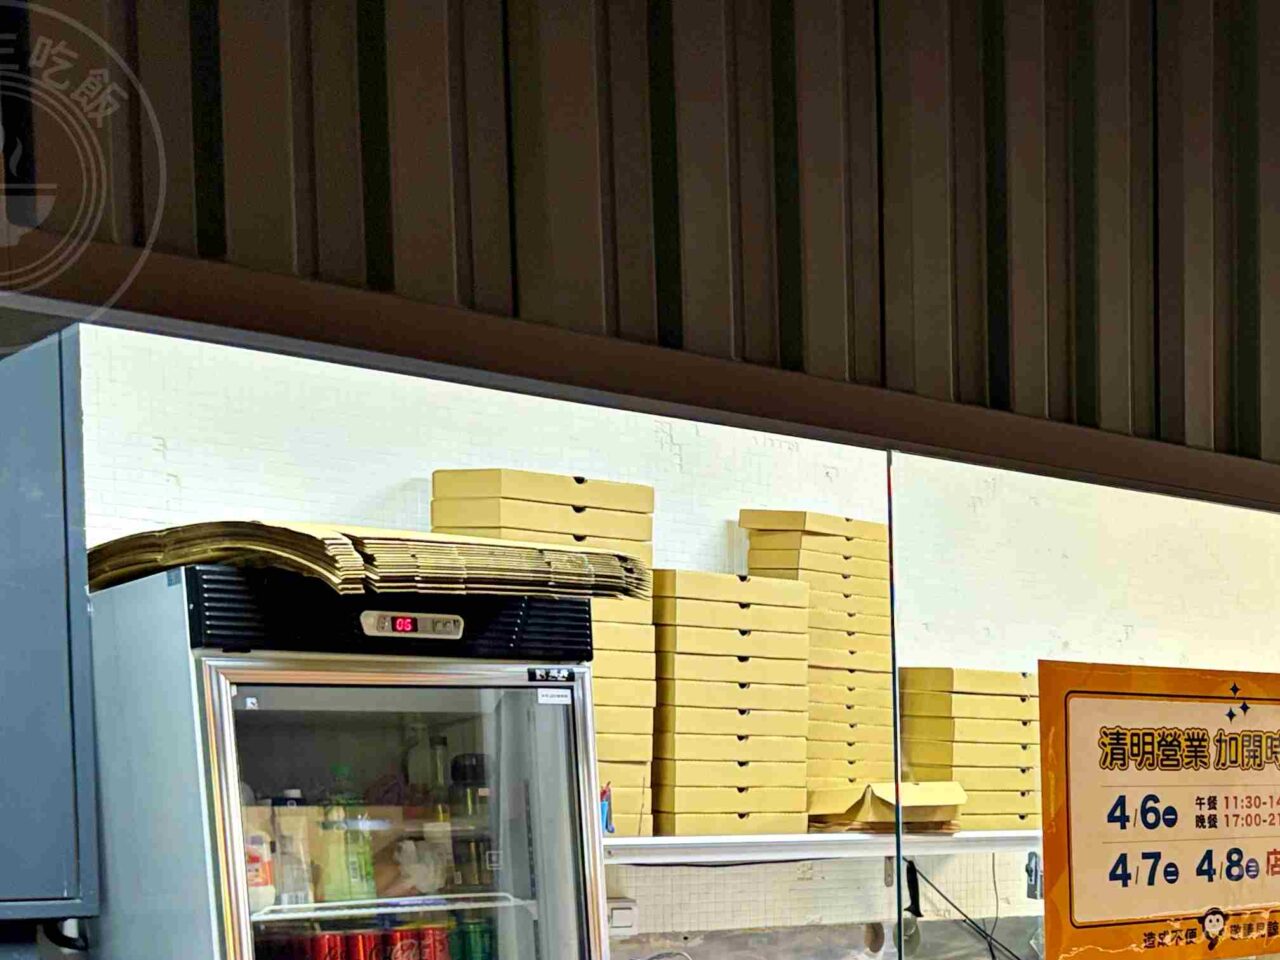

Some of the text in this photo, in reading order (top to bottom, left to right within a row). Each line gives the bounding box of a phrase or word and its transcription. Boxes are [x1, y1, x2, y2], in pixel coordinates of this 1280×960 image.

[1100, 727, 1209, 769] 清明營業
[1195, 795, 1218, 811] 午餐
[1195, 814, 1218, 829] 晚餐
